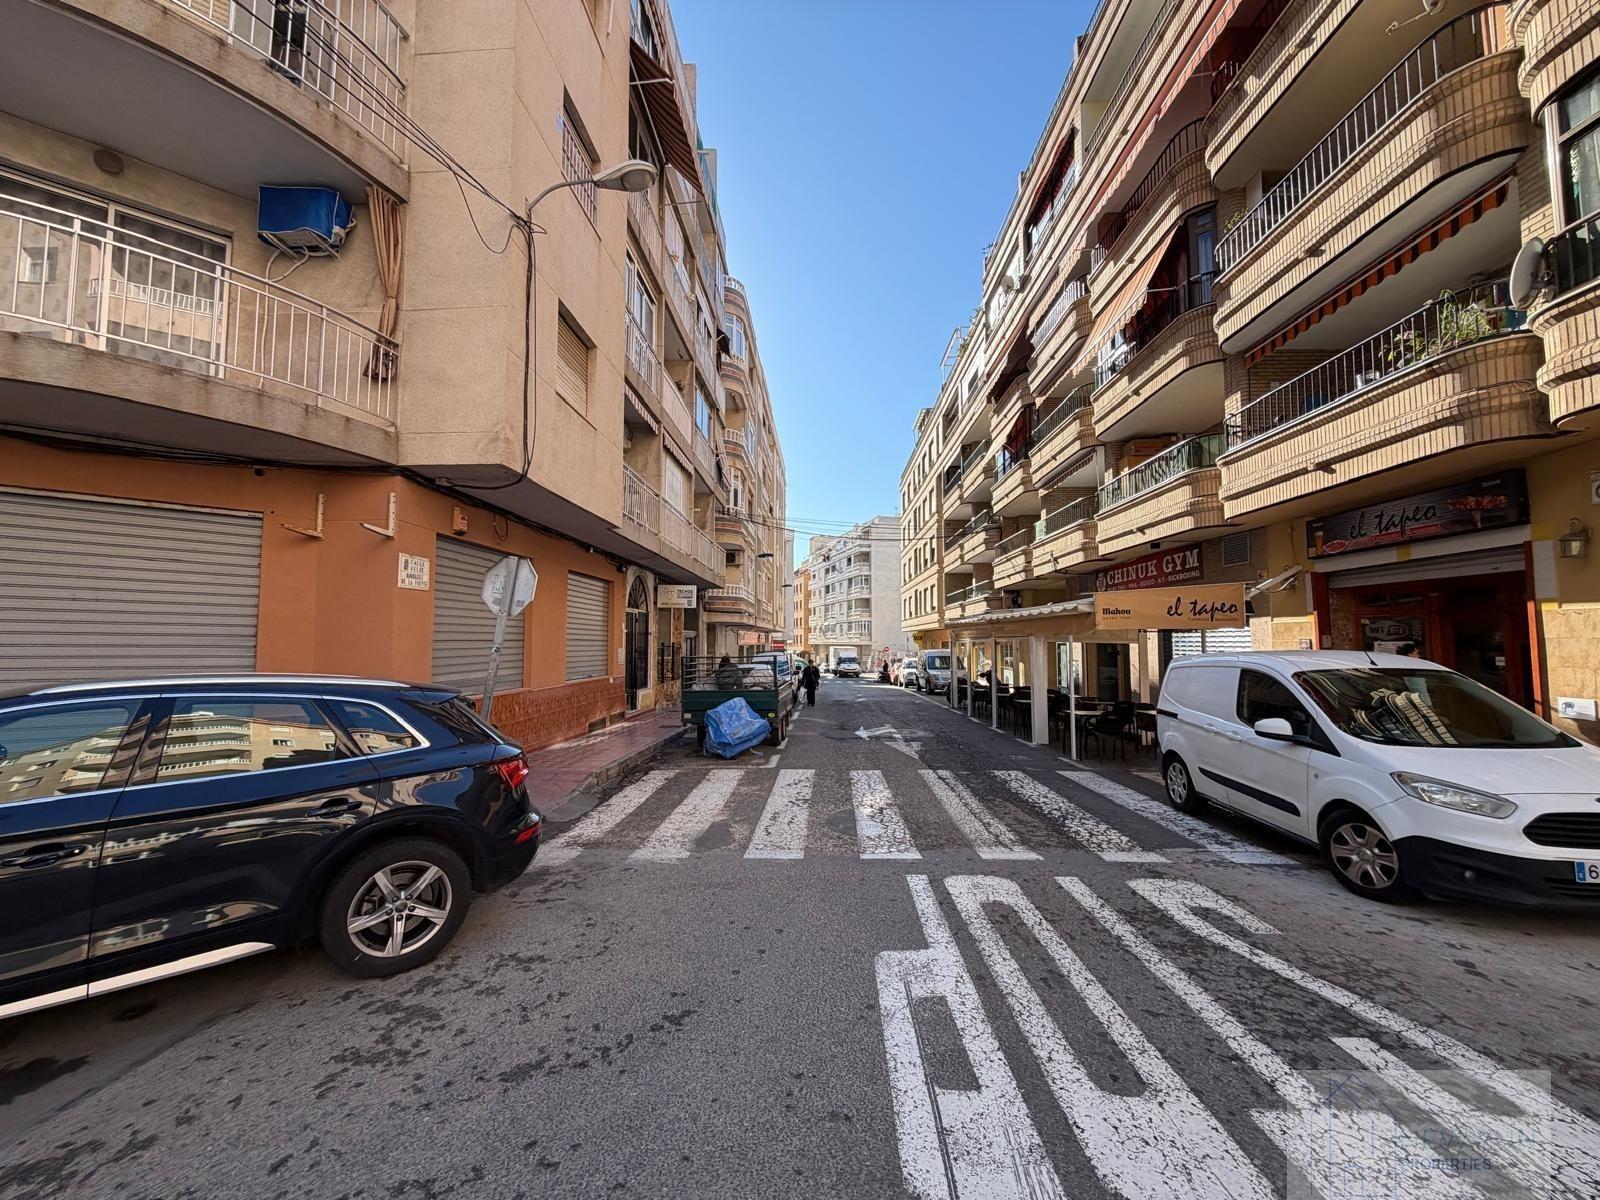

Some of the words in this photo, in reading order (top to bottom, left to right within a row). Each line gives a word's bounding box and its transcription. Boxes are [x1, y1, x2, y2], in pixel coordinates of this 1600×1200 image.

[1350, 510, 1367, 539] el
[1374, 503, 1438, 538] tapeo
[1107, 560, 1157, 585] CHINUK
[1162, 549, 1200, 573] GYM
[1168, 570, 1200, 582] KICKBOXING
[1102, 607, 1131, 615] Mahou
[1167, 596, 1183, 617] el
[1189, 599, 1239, 622] tapeo
